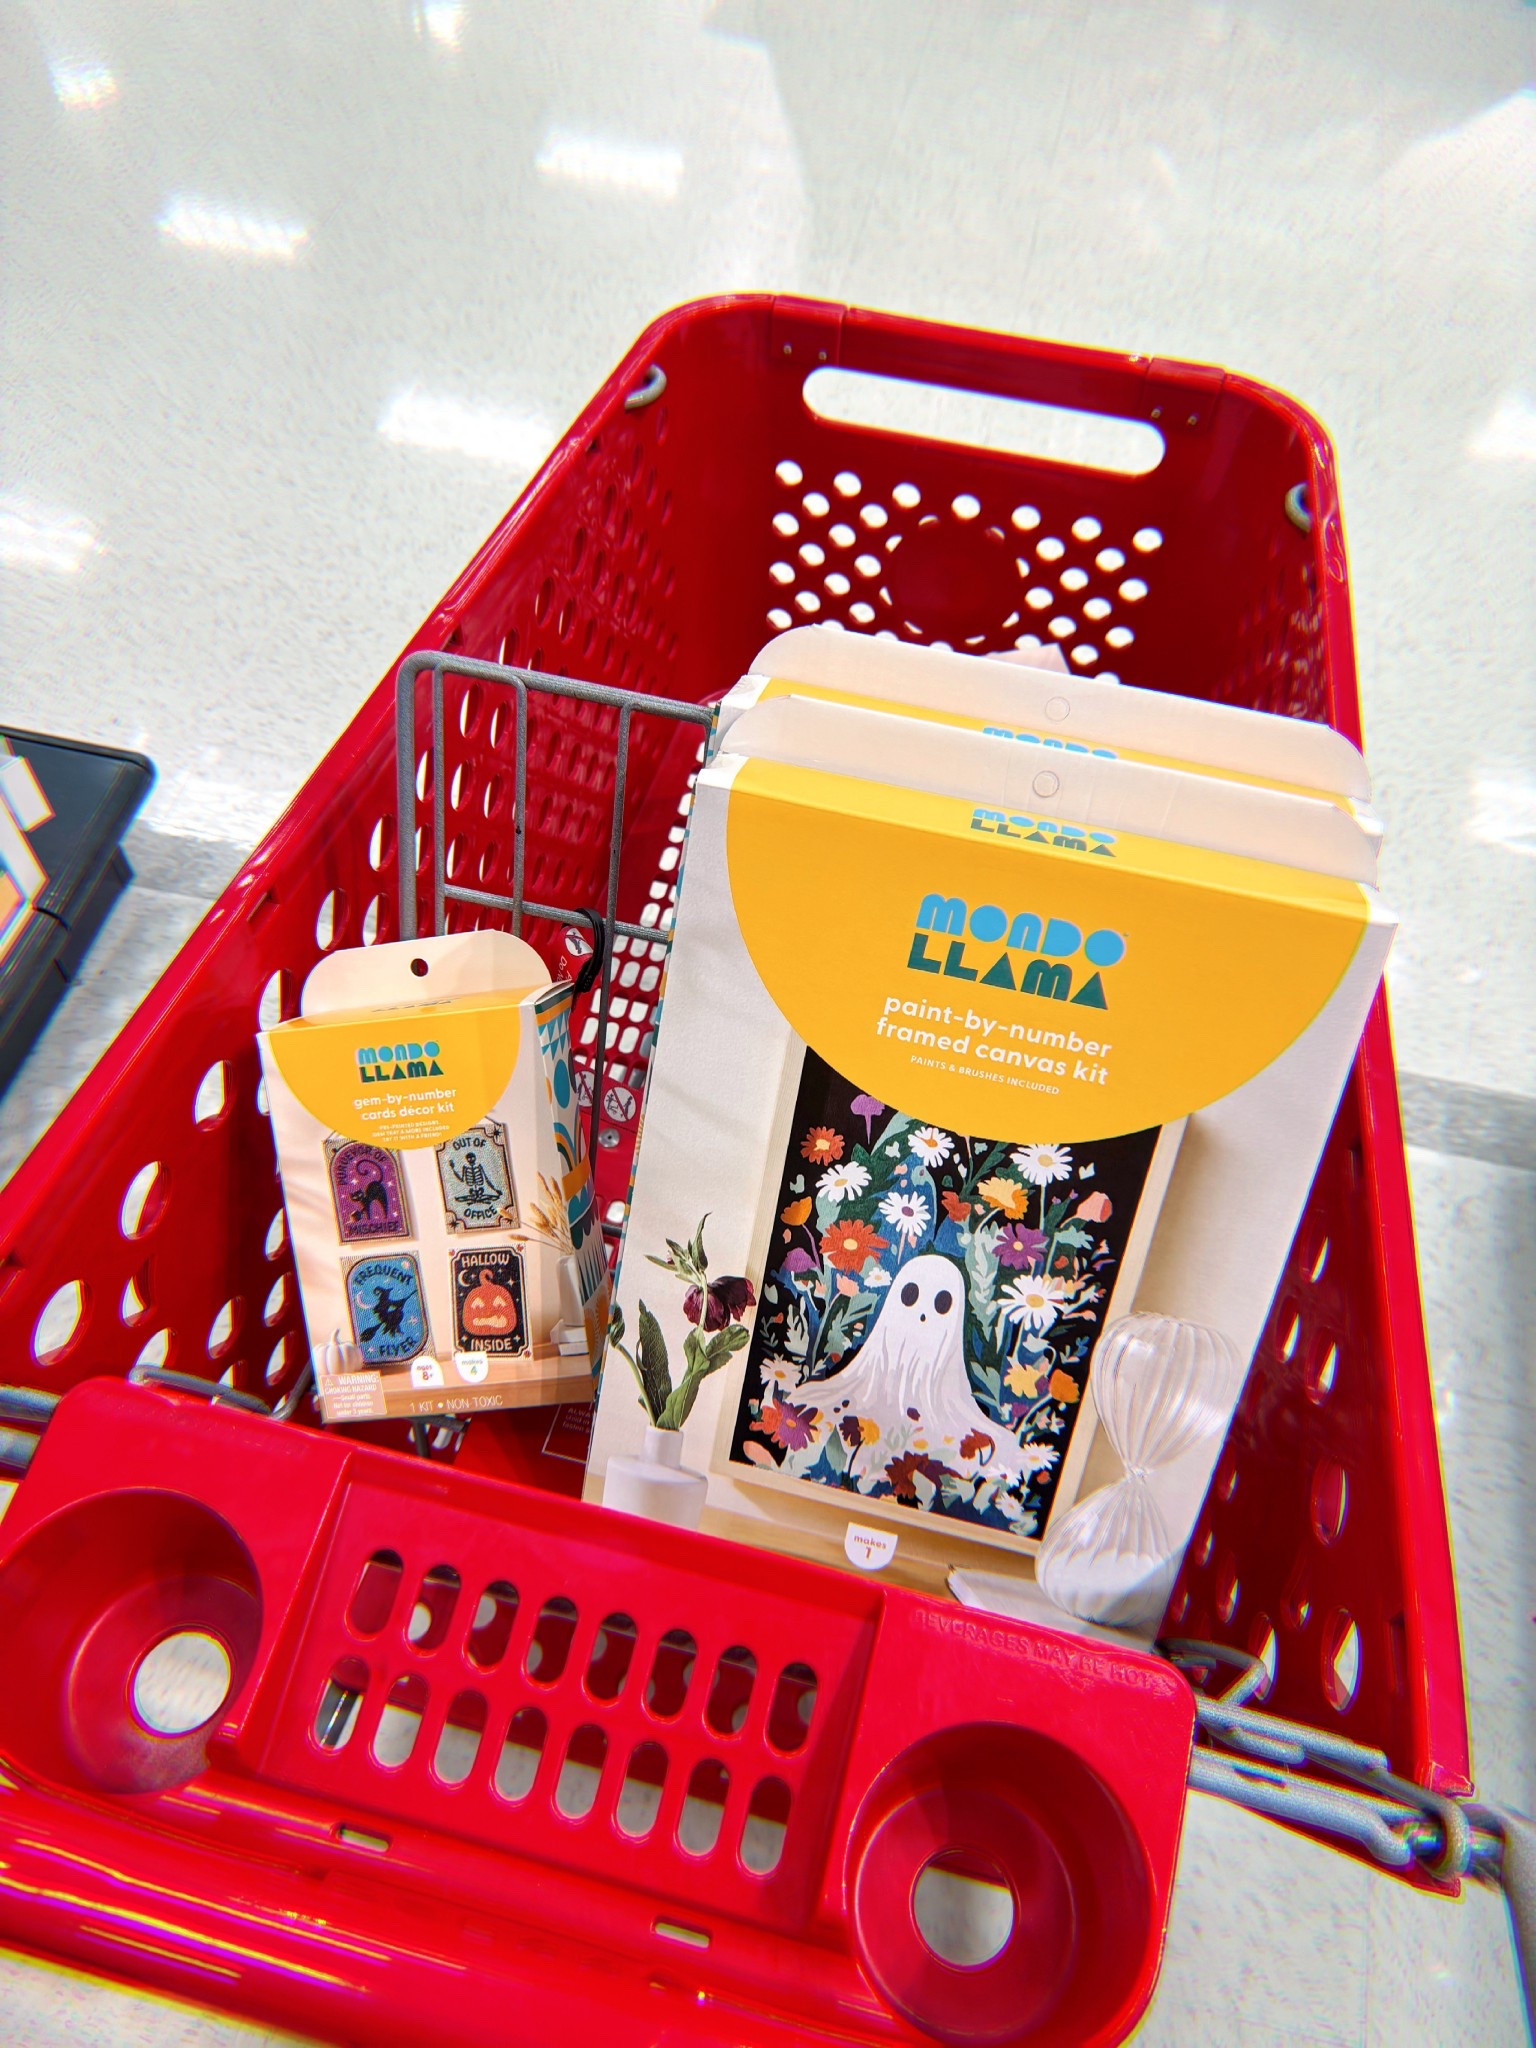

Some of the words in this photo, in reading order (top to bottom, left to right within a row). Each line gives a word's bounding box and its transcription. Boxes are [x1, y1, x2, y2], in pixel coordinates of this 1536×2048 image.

[972, 808, 1116, 844] MONDO
[971, 818, 1117, 857] LLAMA
[915, 893, 1126, 967] MONDO
[907, 932, 1108, 1010] LLAMA
[883, 996, 1112, 1058] paint-by-number
[356, 1040, 440, 1065] MONDO
[876, 1017, 971, 1055] framed
[975, 1042, 1067, 1077] canvas
[1073, 1059, 1108, 1086] kit
[359, 1059, 444, 1083] LLAMA
[910, 1055, 946, 1070] PAINTS
[949, 1063, 956, 1073] &
[958, 1066, 1004, 1084] BRUSHES
[1007, 1077, 1060, 1096] INCLUDED
[353, 1088, 457, 1110] gem-by-number
[361, 1109, 397, 1121] cards
[399, 1105, 435, 1118] décor
[437, 1101, 455, 1112] kit
[452, 1137, 472, 1151] OUT
[473, 1137, 487, 1148] OF
[463, 1205, 498, 1220] OFFICE
[348, 1220, 400, 1235] MISCHIEF
[461, 1252, 510, 1268] HALLOW
[353, 1263, 414, 1286] FREQUENT
[379, 1336, 418, 1357] FLYER
[470, 1337, 513, 1352] INSIDE
[339, 1373, 380, 1385] WARNING:
[422, 1371, 433, 1381] 8+
[470, 1365, 478, 1376] 4
[352, 1383, 377, 1393] HAZARD
[409, 1402, 415, 1413] 1
[419, 1401, 434, 1412] KIT
[853, 1535, 887, 1549] makes
[866, 1546, 871, 1559] 1
[914, 1609, 1030, 1653] BEVERAGES
[1033, 1640, 1073, 1667] MAY
[1079, 1656, 1105, 1675] BE
